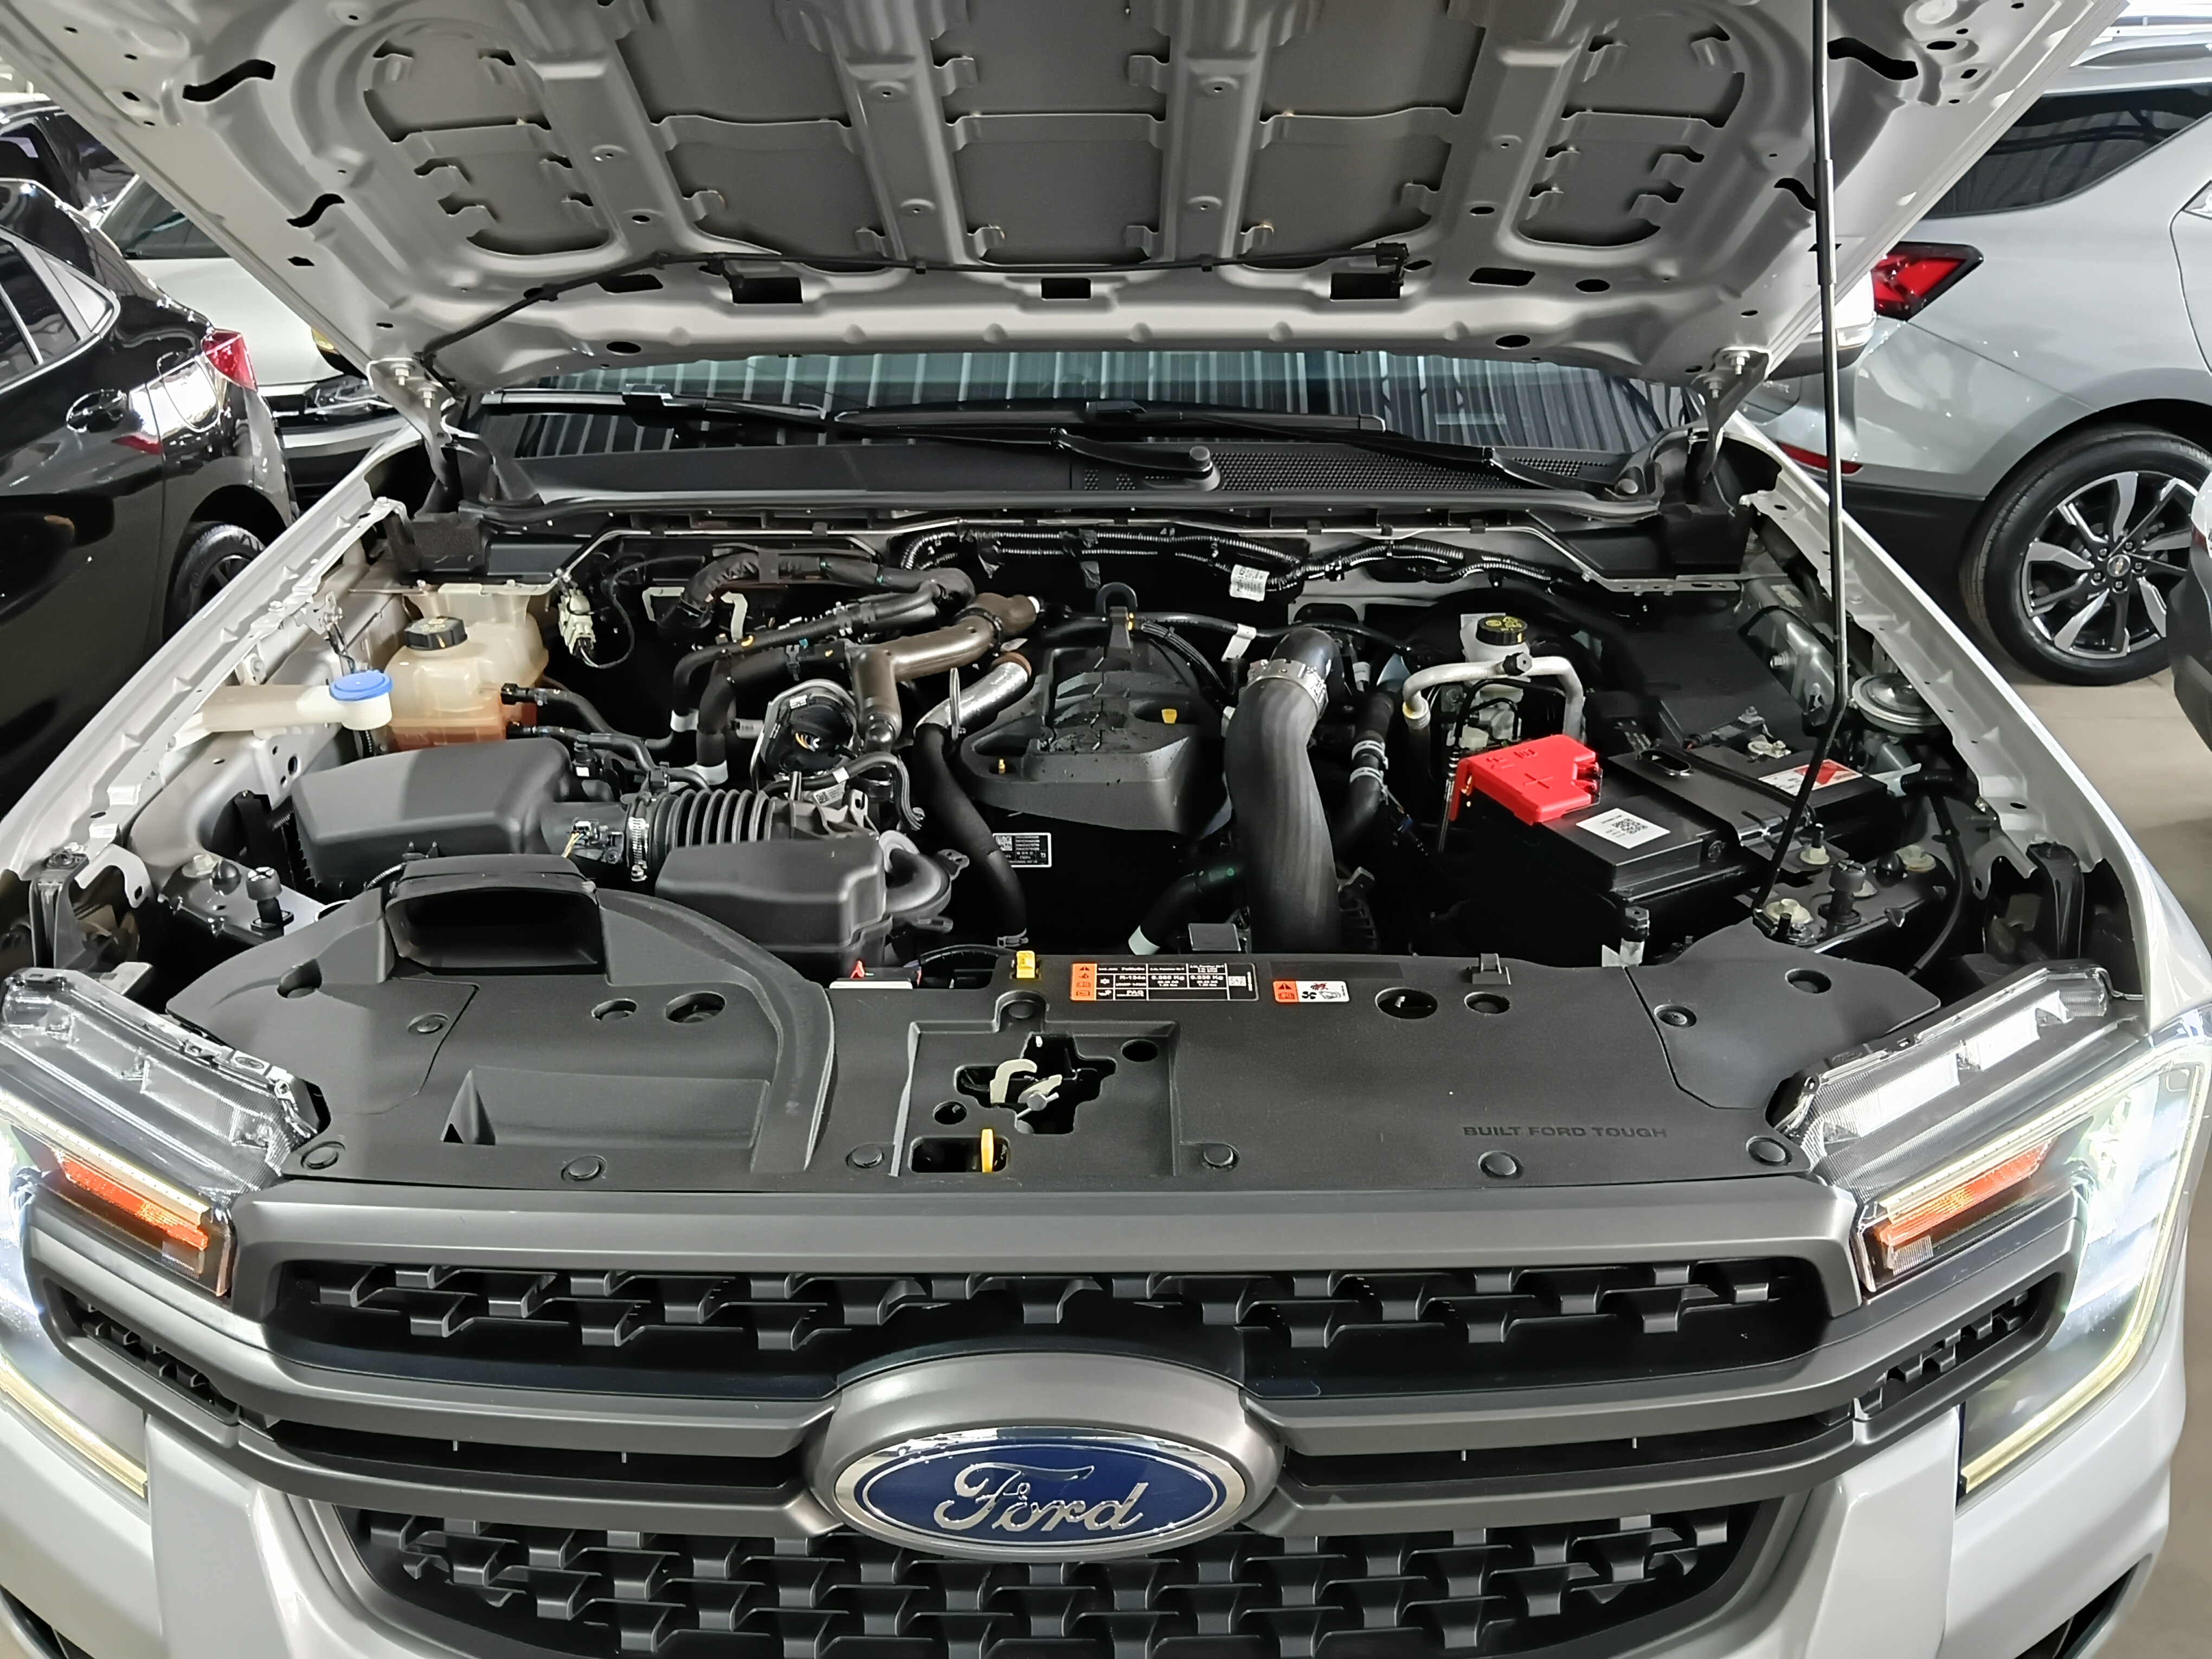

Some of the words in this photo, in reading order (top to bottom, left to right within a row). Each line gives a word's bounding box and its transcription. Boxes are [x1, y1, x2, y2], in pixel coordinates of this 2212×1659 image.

[1462, 1126, 1521, 1136] BUILT
[1527, 1126, 1587, 1137] FORD
[1591, 1127, 1667, 1138] TOUGH
[933, 1461, 1149, 1532] Ford
